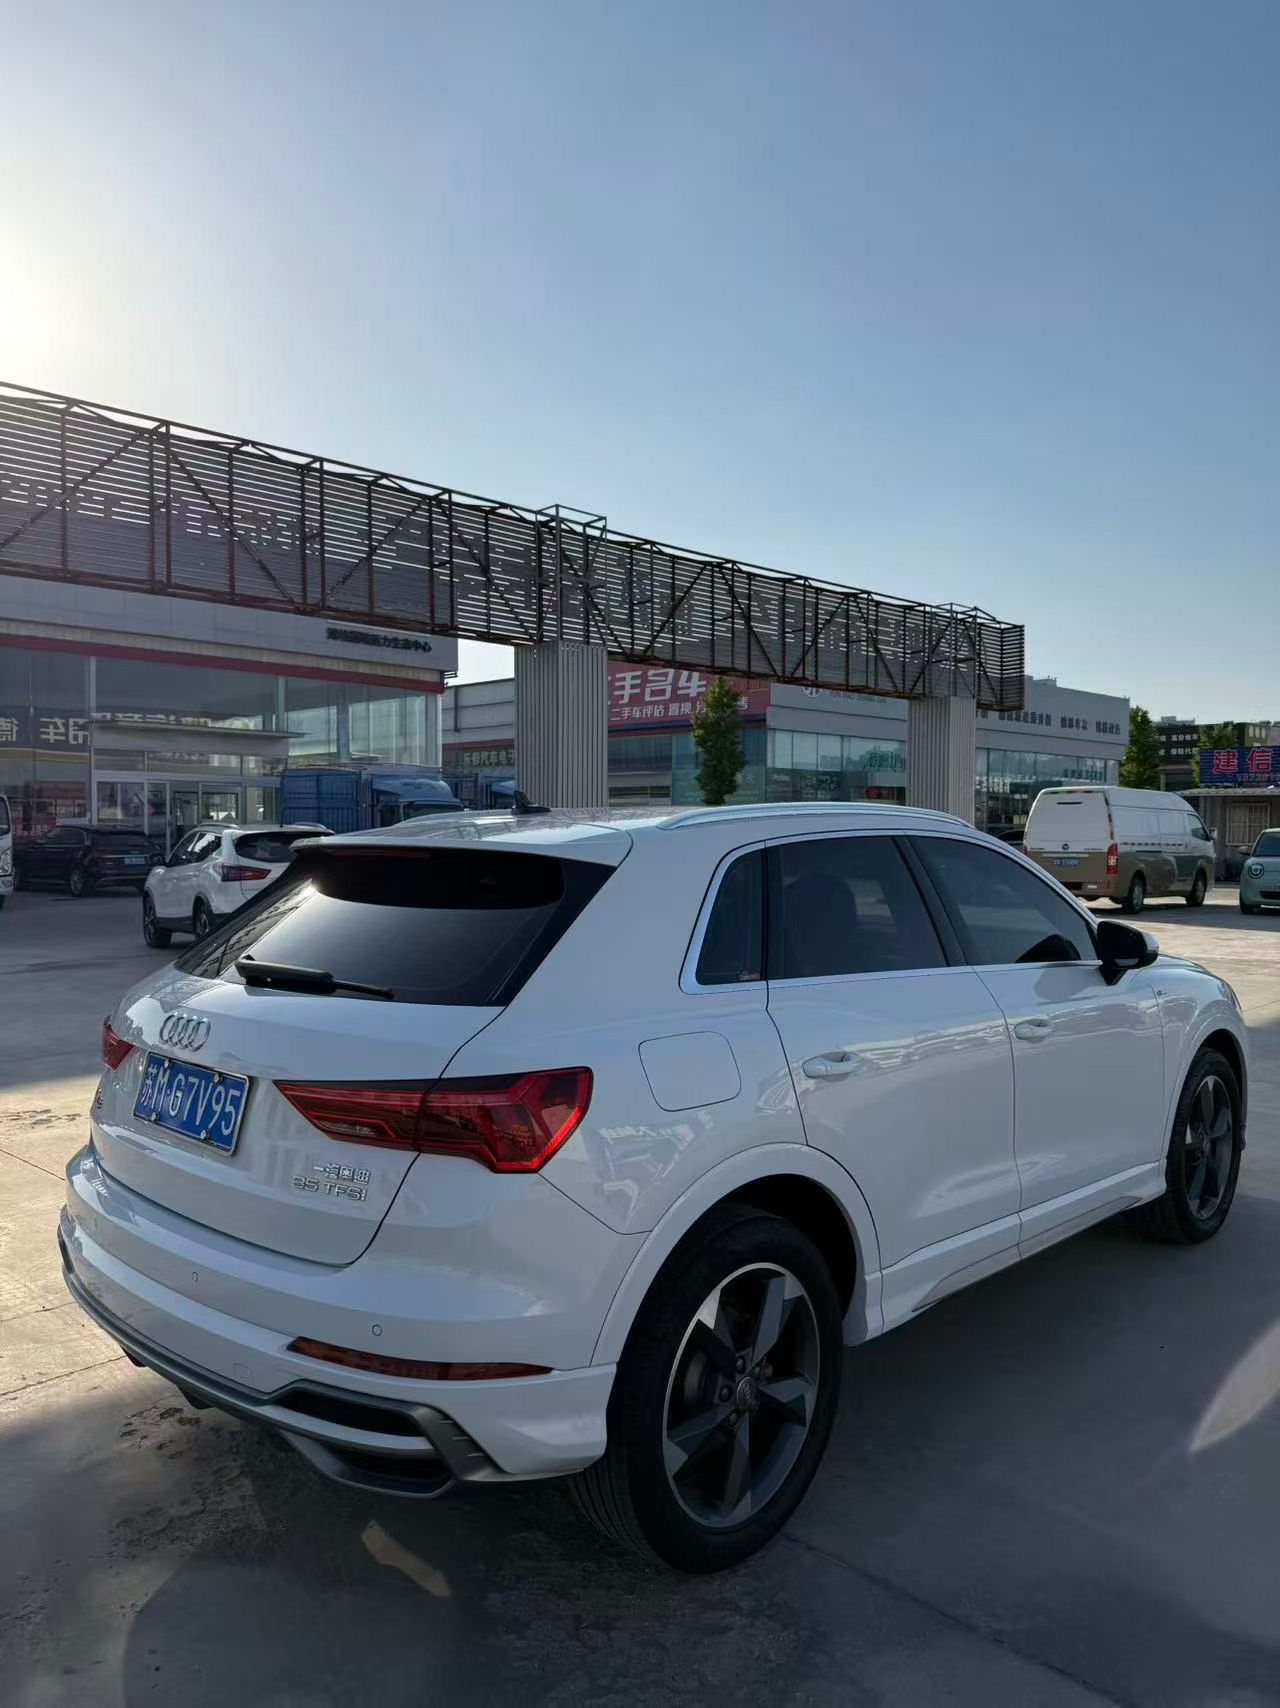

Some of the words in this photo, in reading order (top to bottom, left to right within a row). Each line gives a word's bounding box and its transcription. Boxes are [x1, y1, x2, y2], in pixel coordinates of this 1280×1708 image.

[608, 668, 706, 704] 手名车
[610, 704, 665, 720] 二手车评估
[668, 703, 691, 716] 置换
[313, 1163, 371, 1185] 一汽奥迪
[293, 1176, 319, 1192] 35
[322, 1181, 367, 1201] TFSI
